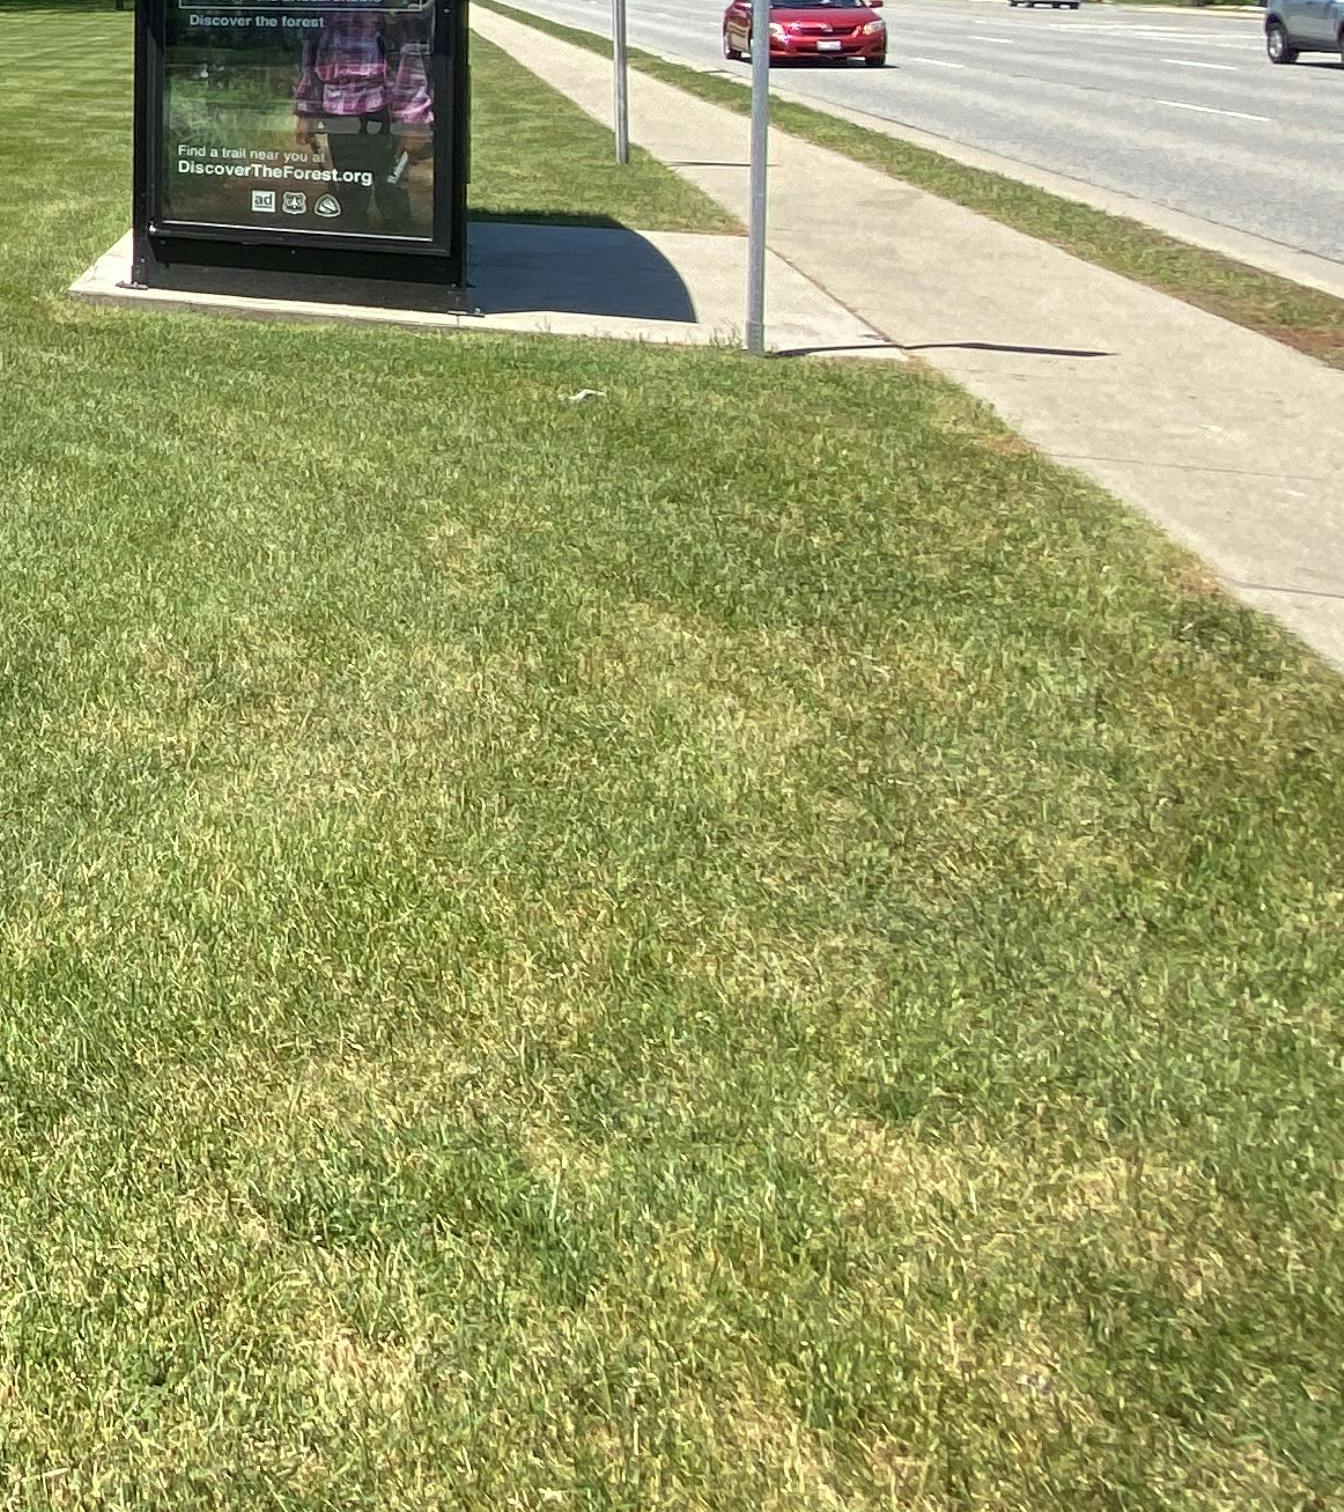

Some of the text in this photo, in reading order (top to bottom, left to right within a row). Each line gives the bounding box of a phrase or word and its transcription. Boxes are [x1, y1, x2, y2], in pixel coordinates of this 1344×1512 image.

[189, 14, 325, 28] Discover the forest
[177, 144, 326, 164] Find a trail near you at
[177, 160, 373, 186] DiscoverTheForest.org
[254, 193, 273, 205] ad
